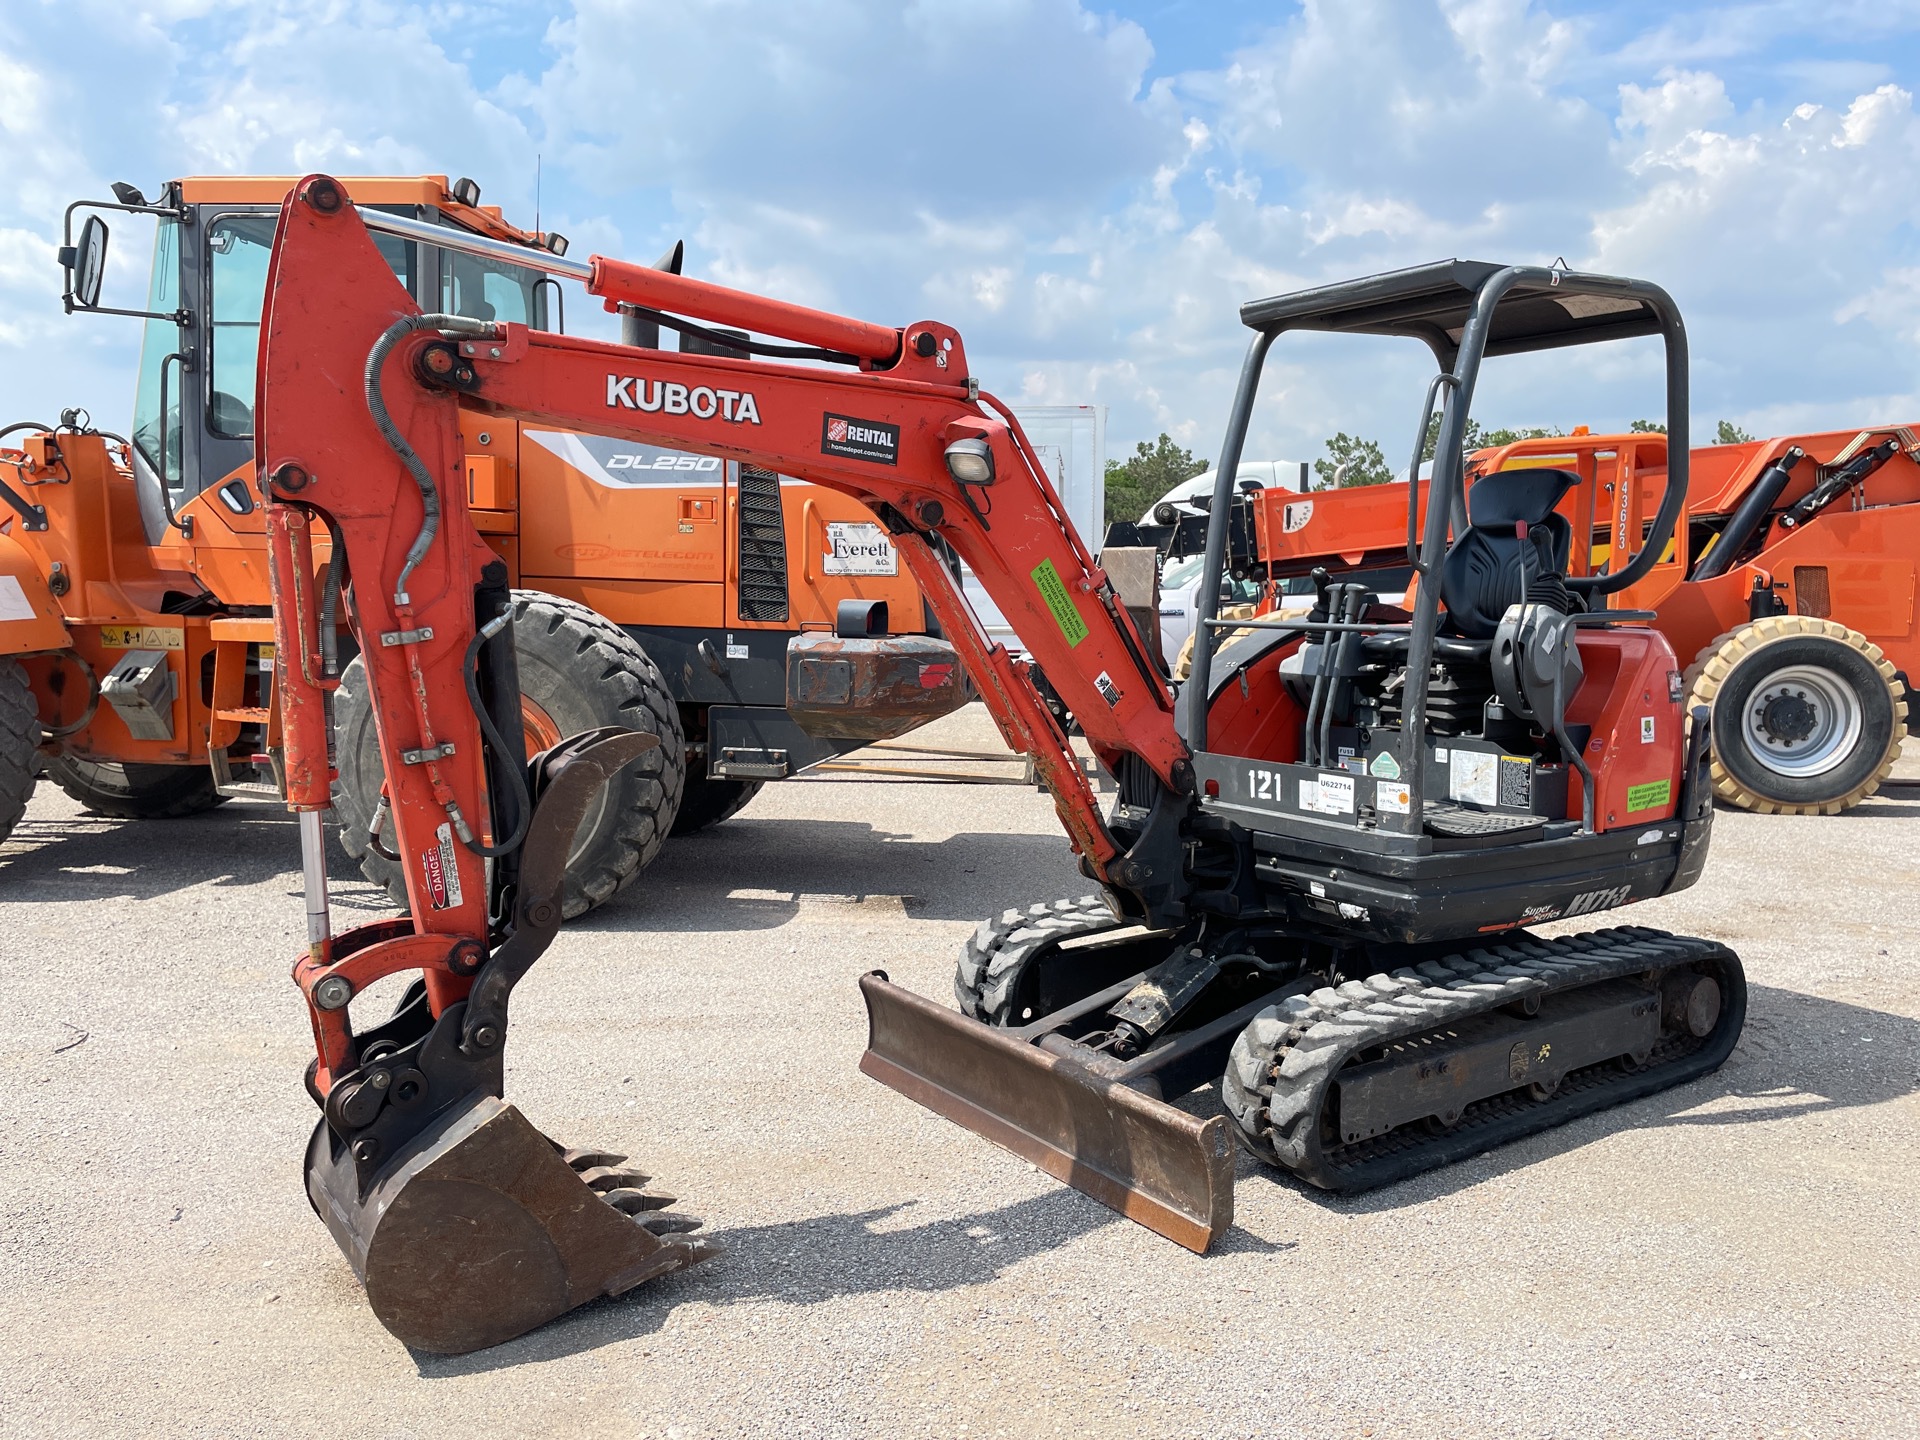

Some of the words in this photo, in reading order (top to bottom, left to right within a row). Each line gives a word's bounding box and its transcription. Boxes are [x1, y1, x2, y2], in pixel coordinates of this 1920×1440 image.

[606, 374, 761, 425] KUBOTA
[828, 420, 847, 440] HOME
[848, 426, 894, 448] RENTAL
[831, 443, 893, 460] homedepot.com/rental
[606, 454, 720, 472] DL250
[1618, 466, 1628, 550] 143623
[833, 538, 888, 558] Everett
[1043, 574, 1058, 600] CHARGED
[1067, 617, 1081, 640] MACHINE
[1047, 594, 1064, 621] RETURNED
[1062, 621, 1073, 638] CLEAN
[1055, 583, 1070, 609] CLEANING
[1074, 619, 1083, 632] WILL
[1248, 770, 1281, 802] 121
[1320, 780, 1352, 790] U622714
[1523, 904, 1553, 917] Super
[1563, 884, 1632, 917] KX71-3
[1532, 909, 1561, 922] Series
